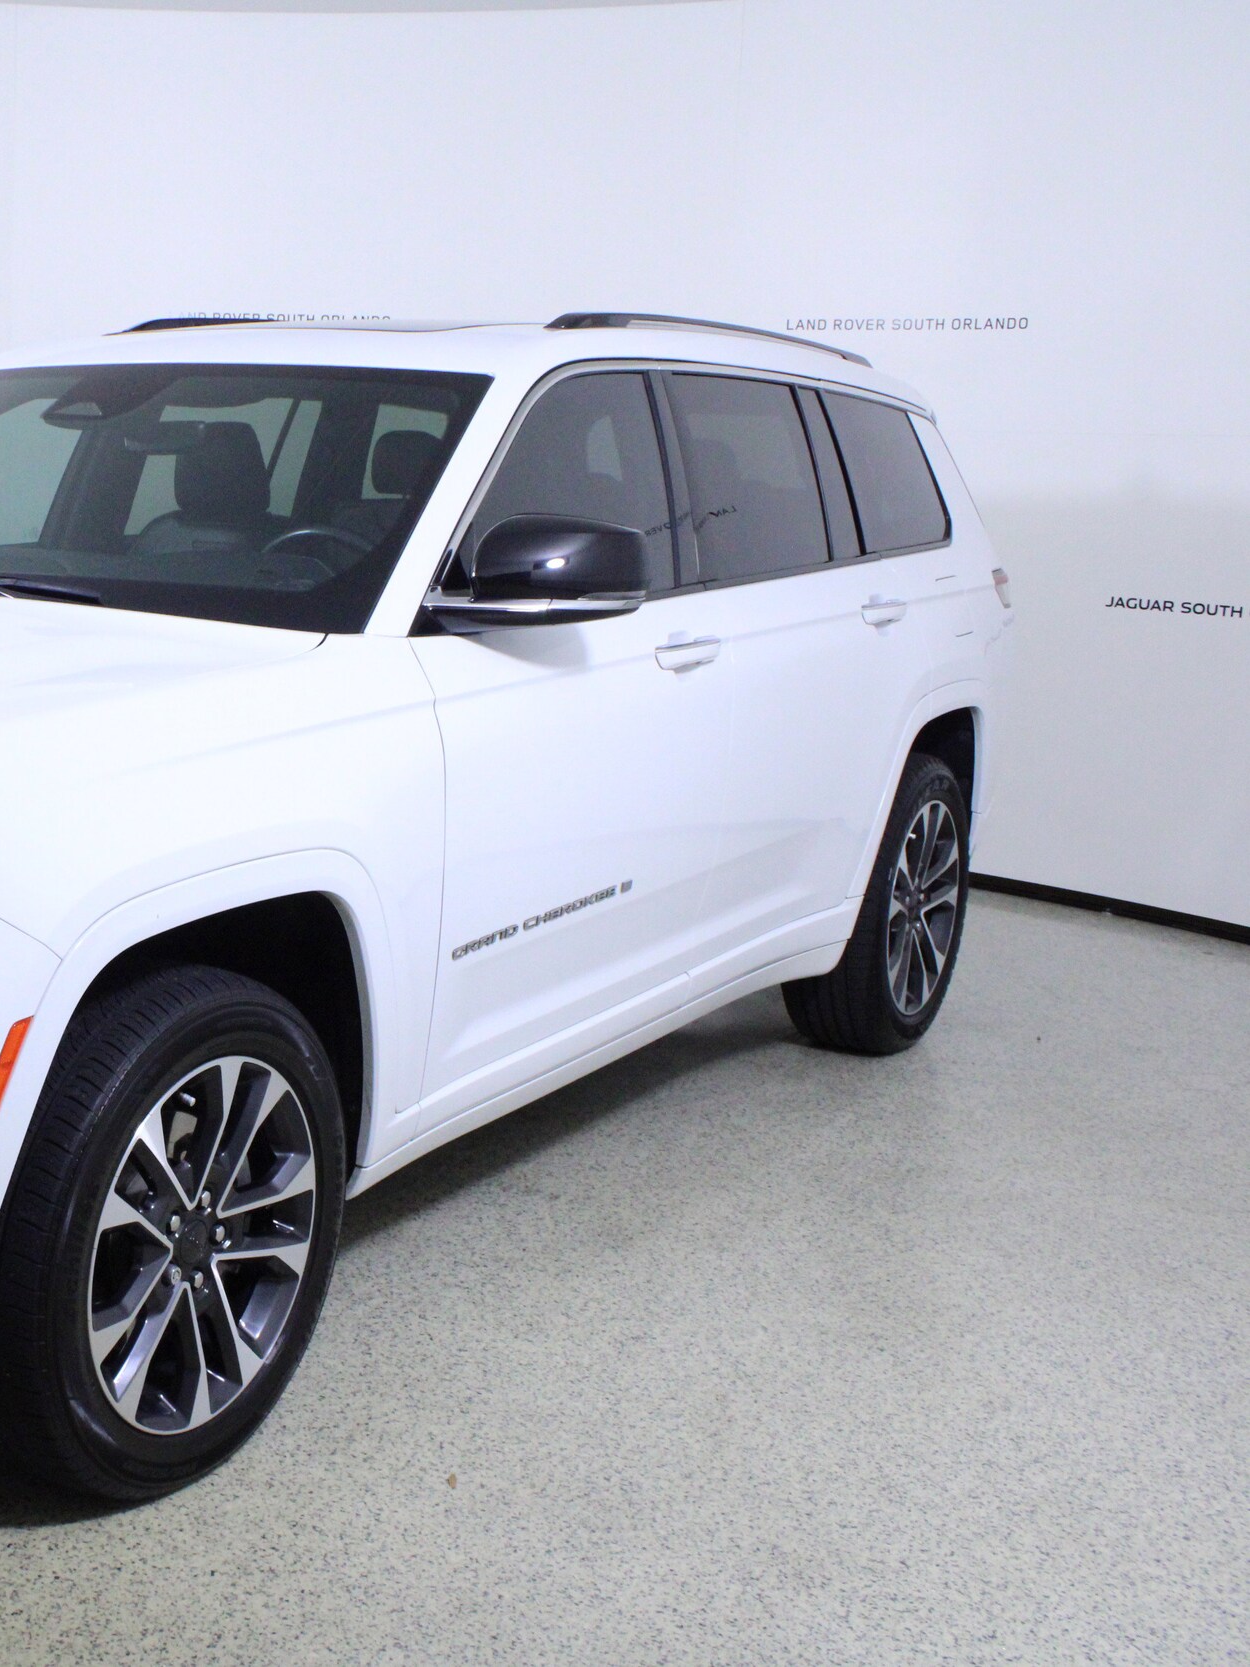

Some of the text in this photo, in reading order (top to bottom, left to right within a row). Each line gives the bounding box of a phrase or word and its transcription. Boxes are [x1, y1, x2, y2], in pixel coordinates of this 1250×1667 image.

[786, 316, 1029, 331] LAND ROVER SOUTH ORLANDO
[1105, 596, 1174, 613] JAGUAR
[1180, 601, 1244, 618] SOUTH
[452, 884, 618, 961] GRAND CHEROKEE
